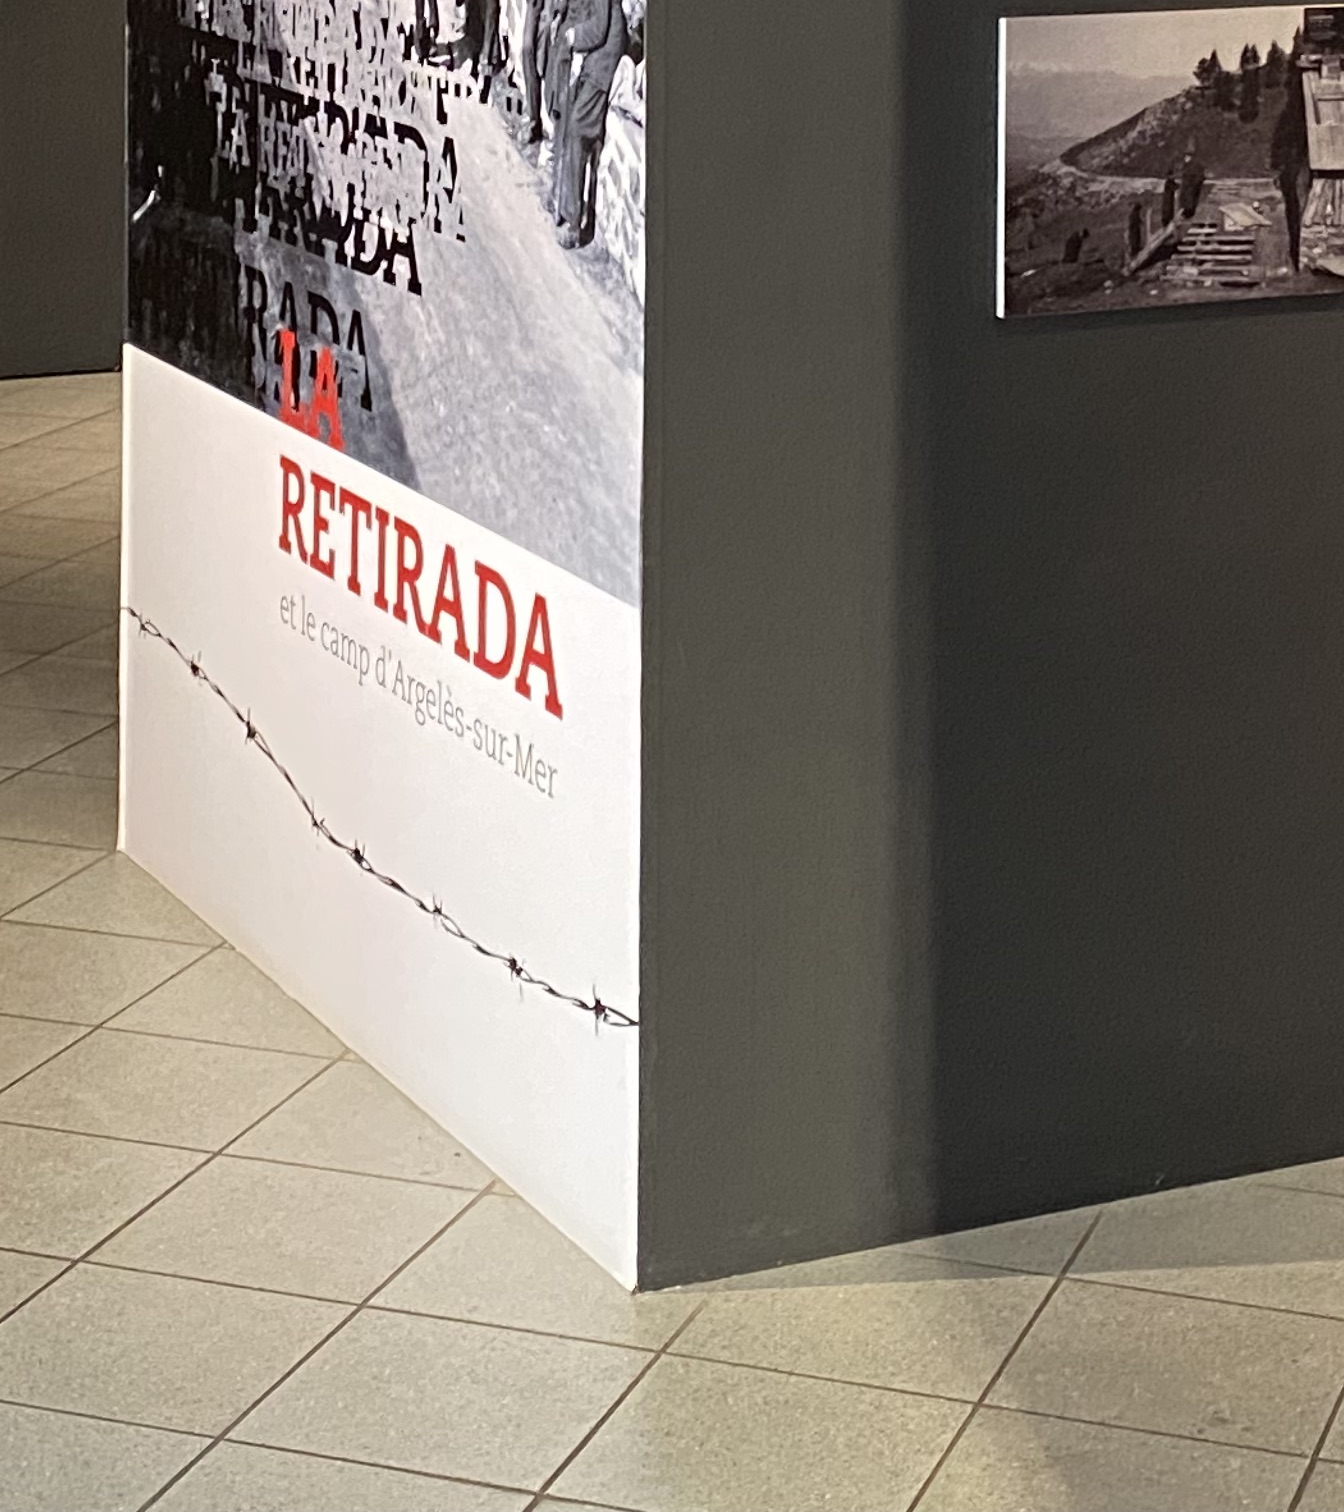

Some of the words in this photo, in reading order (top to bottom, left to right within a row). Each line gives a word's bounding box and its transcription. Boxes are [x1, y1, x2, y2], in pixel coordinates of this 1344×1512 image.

[280, 328, 344, 453] LA
[278, 454, 564, 720] RETIRADA
[279, 592, 296, 630] et
[301, 595, 317, 642] le
[321, 623, 370, 683] camp
[375, 646, 558, 799] d'Argelès-sur-Mer
